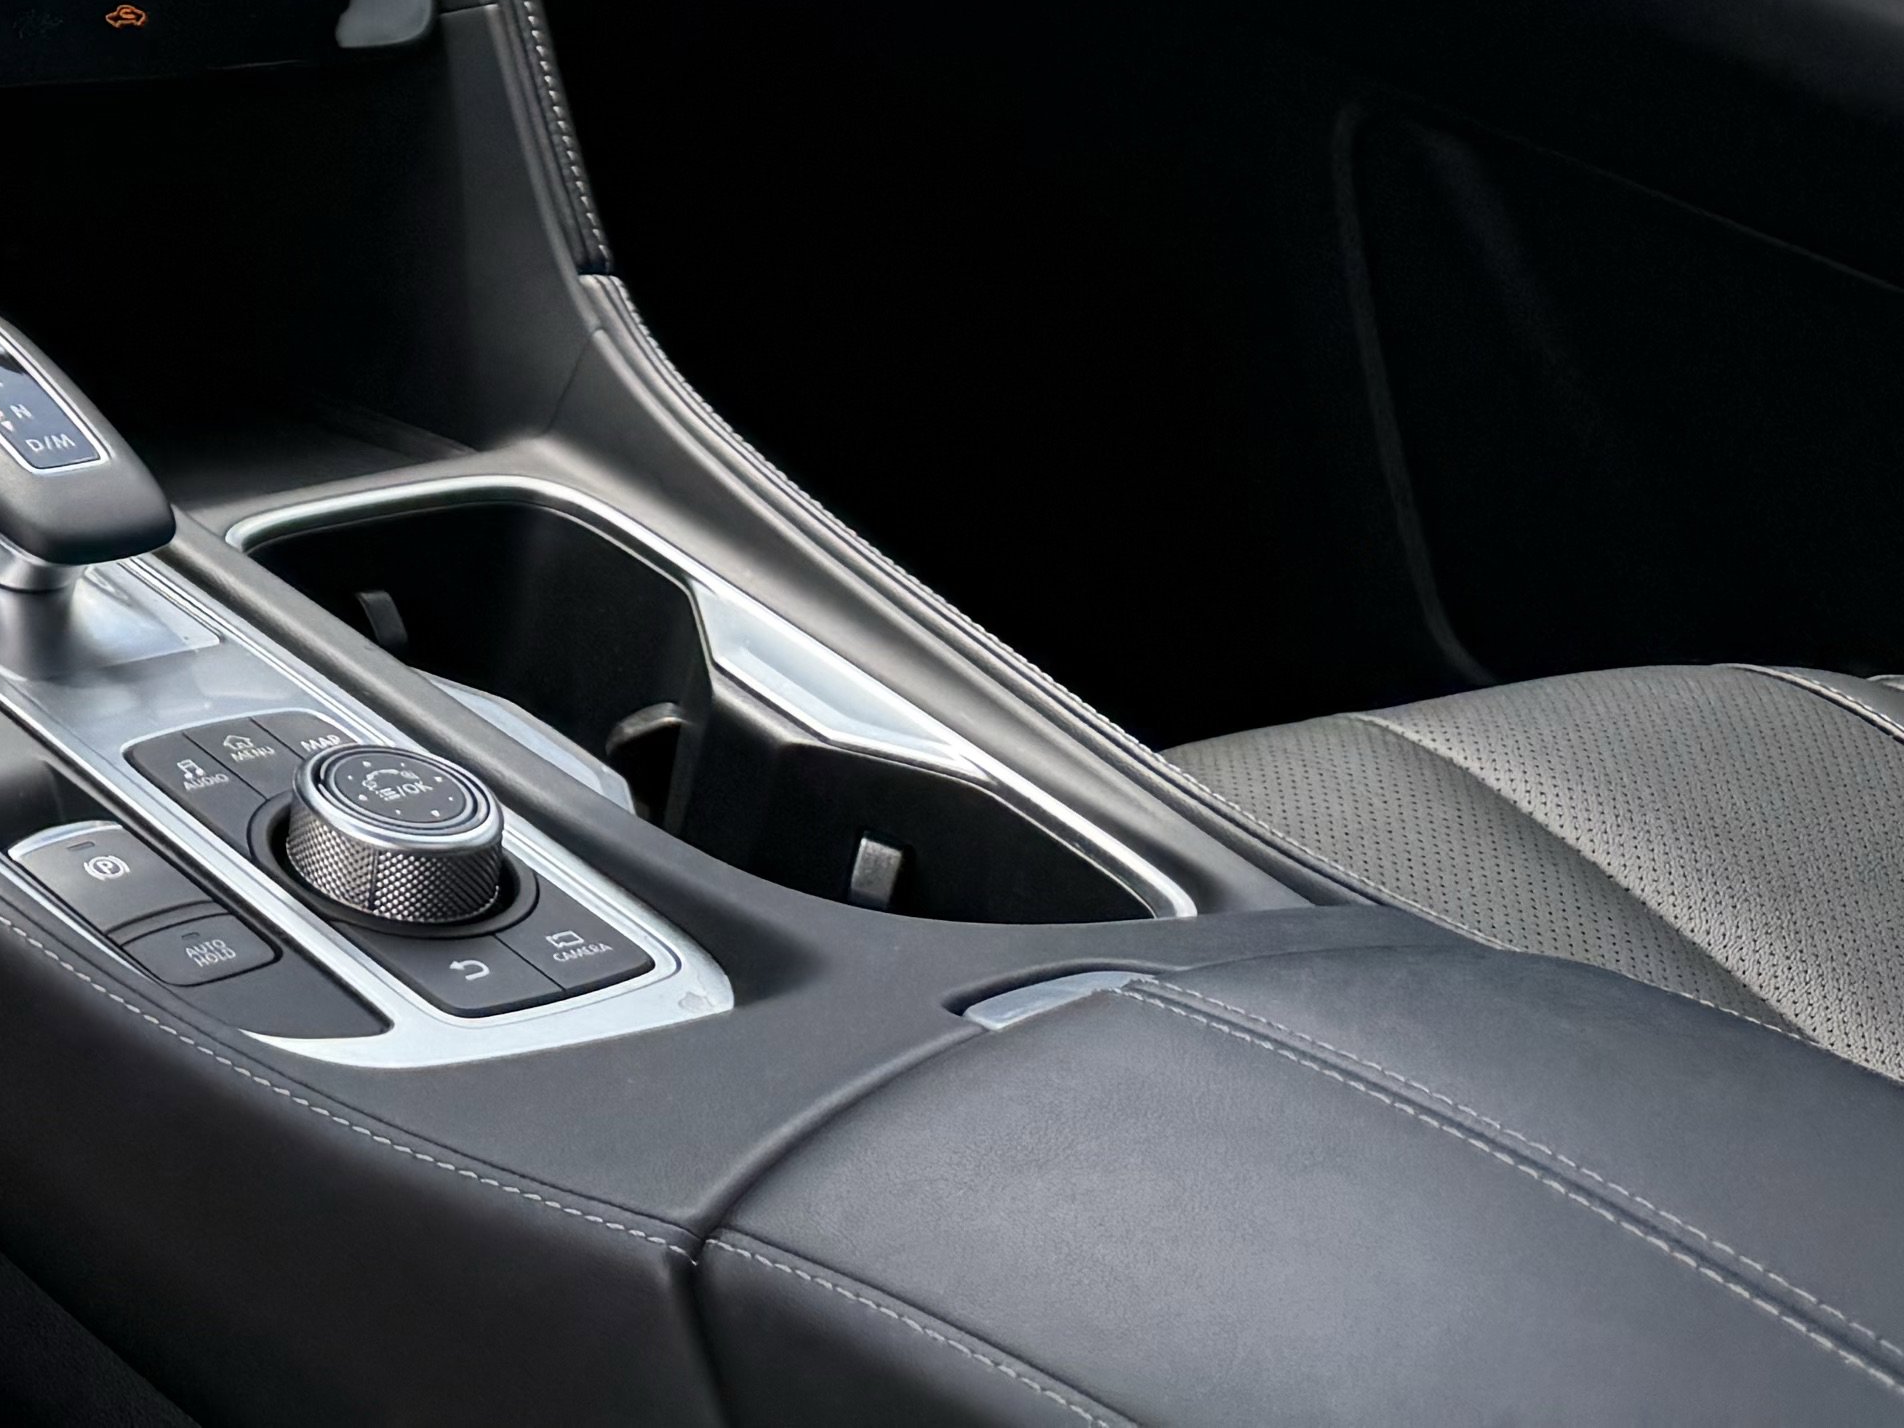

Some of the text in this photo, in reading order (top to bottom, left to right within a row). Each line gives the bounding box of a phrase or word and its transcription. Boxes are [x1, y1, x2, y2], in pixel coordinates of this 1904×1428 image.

[300, 734, 342, 753] MAP
[230, 746, 276, 762] MENU
[182, 773, 230, 792] AUDIO
[185, 938, 227, 960] AUTO
[193, 948, 237, 968] HOLD
[552, 942, 614, 963] CAMERA
